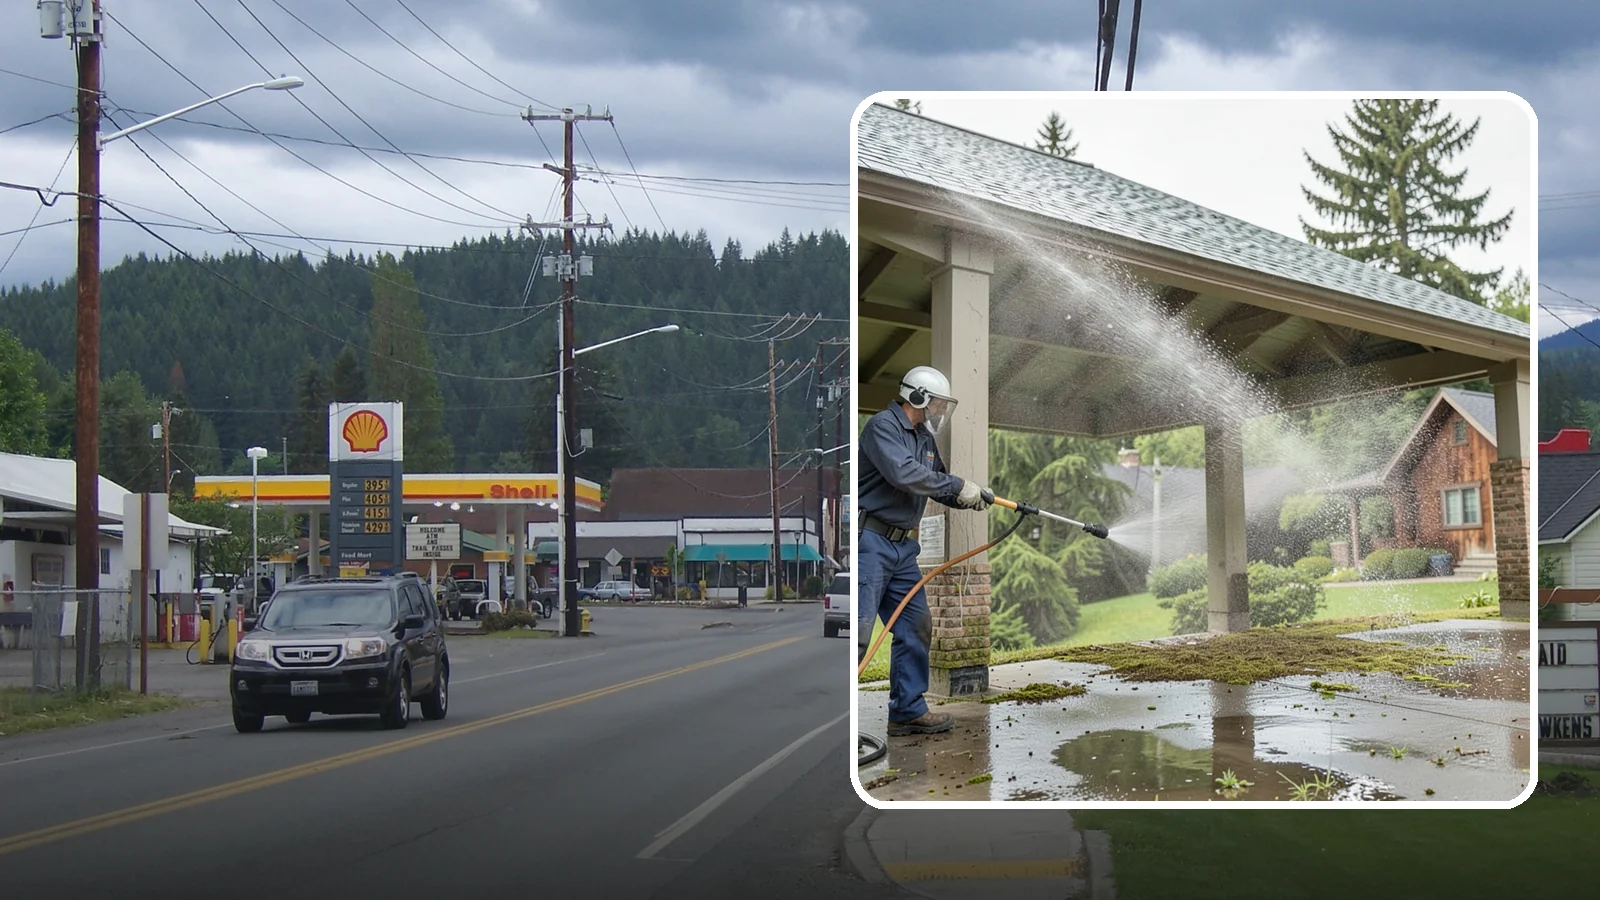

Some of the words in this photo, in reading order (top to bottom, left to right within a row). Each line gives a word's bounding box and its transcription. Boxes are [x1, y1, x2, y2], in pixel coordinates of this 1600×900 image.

[366, 480, 383, 490] 395
[490, 484, 547, 499] Shell
[366, 494, 383, 504] 405
[366, 508, 383, 518] 415
[366, 522, 383, 533] 429
[1538, 642, 1567, 666] AID
